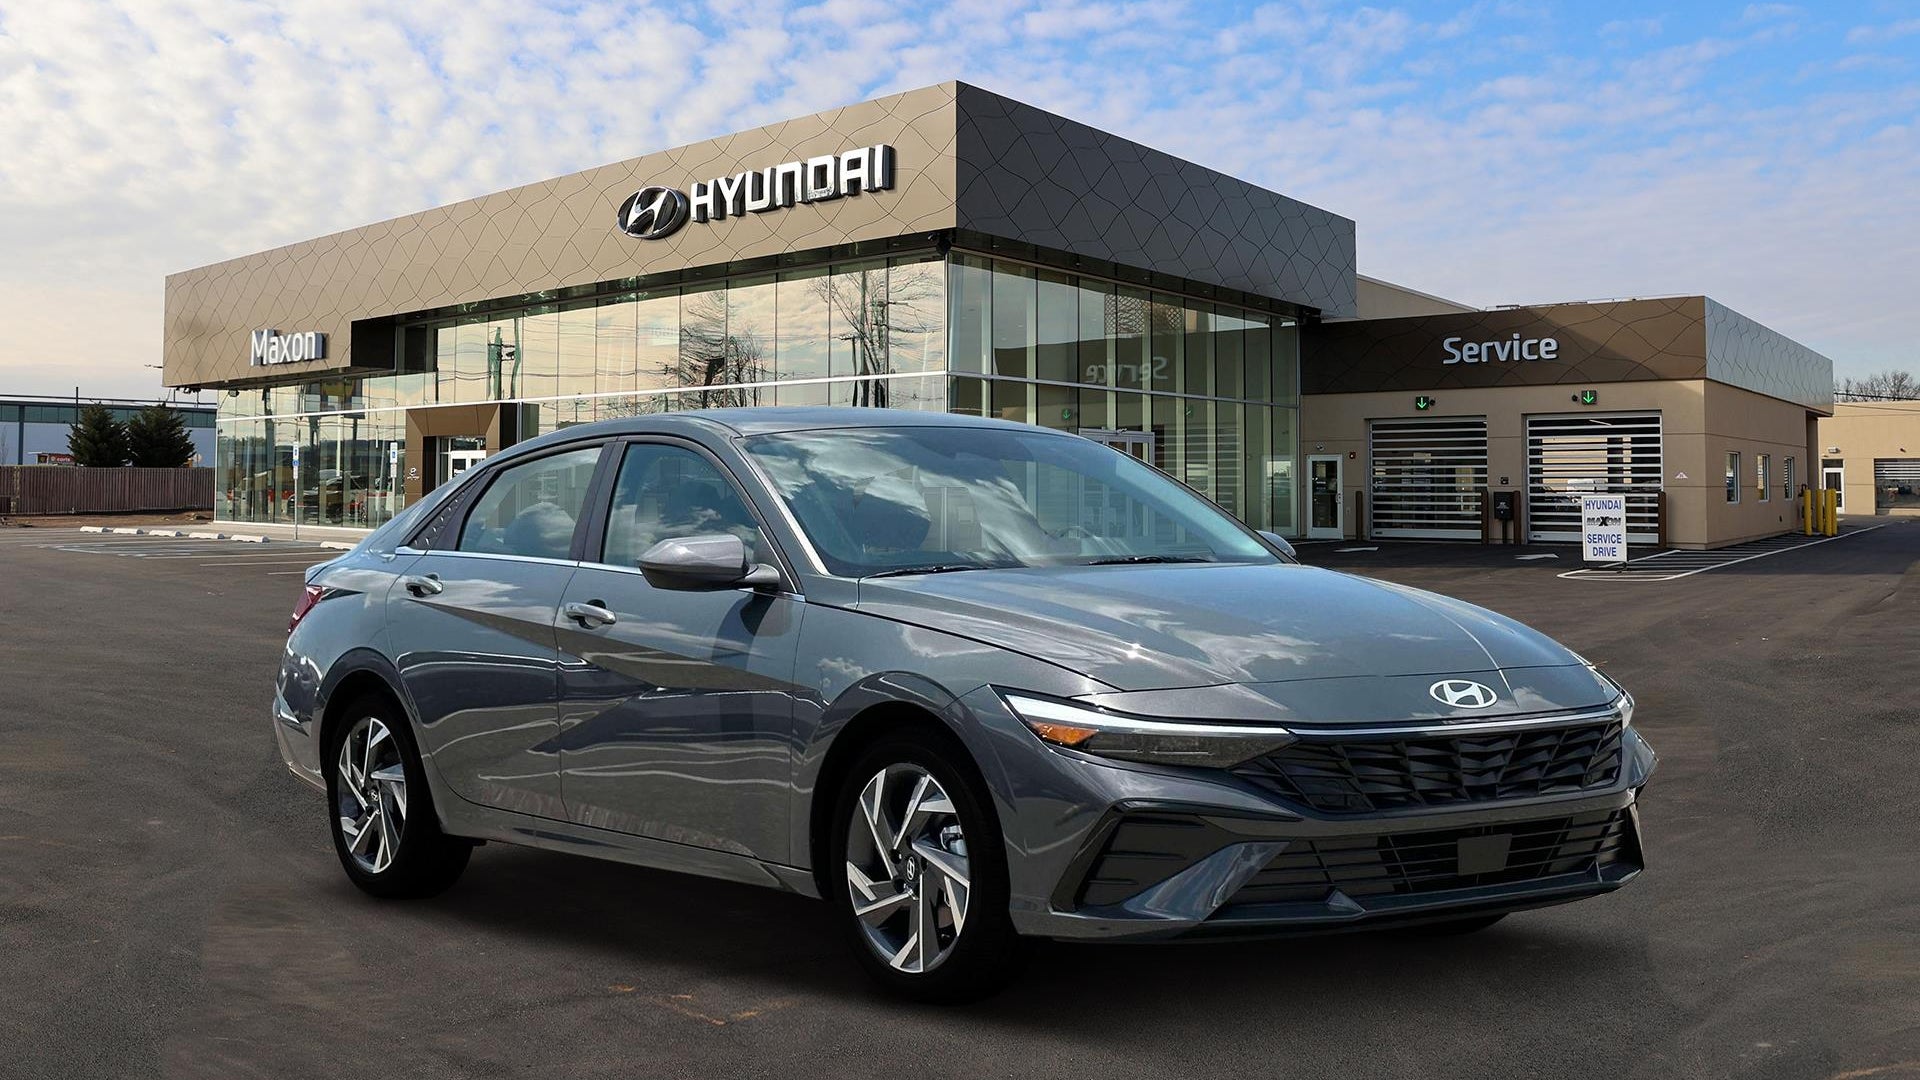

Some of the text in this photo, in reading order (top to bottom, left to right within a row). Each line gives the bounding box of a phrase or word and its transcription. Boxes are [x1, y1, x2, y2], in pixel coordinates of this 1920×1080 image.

[690, 144, 890, 223] HYUNDAI
[250, 329, 320, 366] Maxon
[1443, 333, 1558, 364] Service
[1585, 500, 1622, 510] HYUNDAI
[1587, 533, 1622, 544] SERVICE
[1592, 547, 1617, 557] DRIVE
